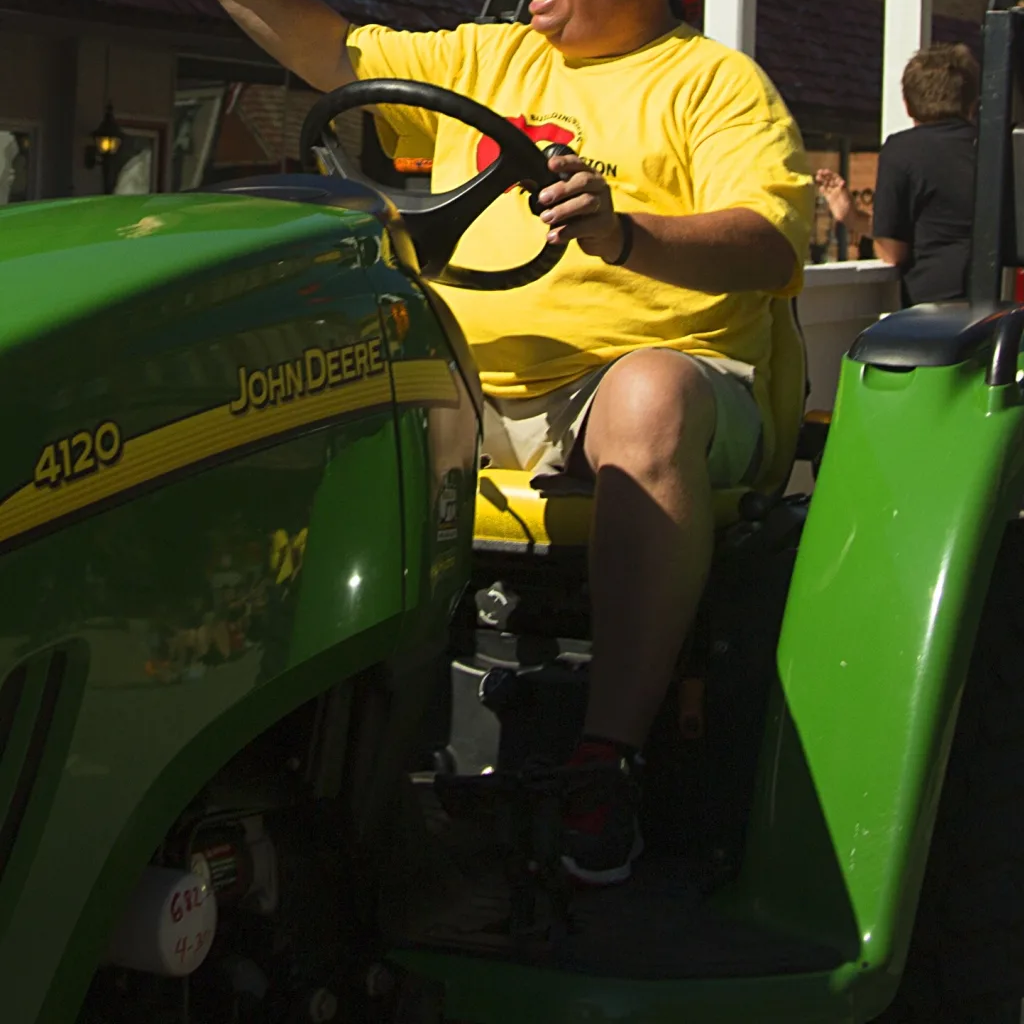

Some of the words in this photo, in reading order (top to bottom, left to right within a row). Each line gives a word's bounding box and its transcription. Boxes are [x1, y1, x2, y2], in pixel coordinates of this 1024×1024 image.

[230, 359, 304, 414] JOHN
[304, 337, 384, 391] DEERE
[34, 419, 122, 486] 4120
